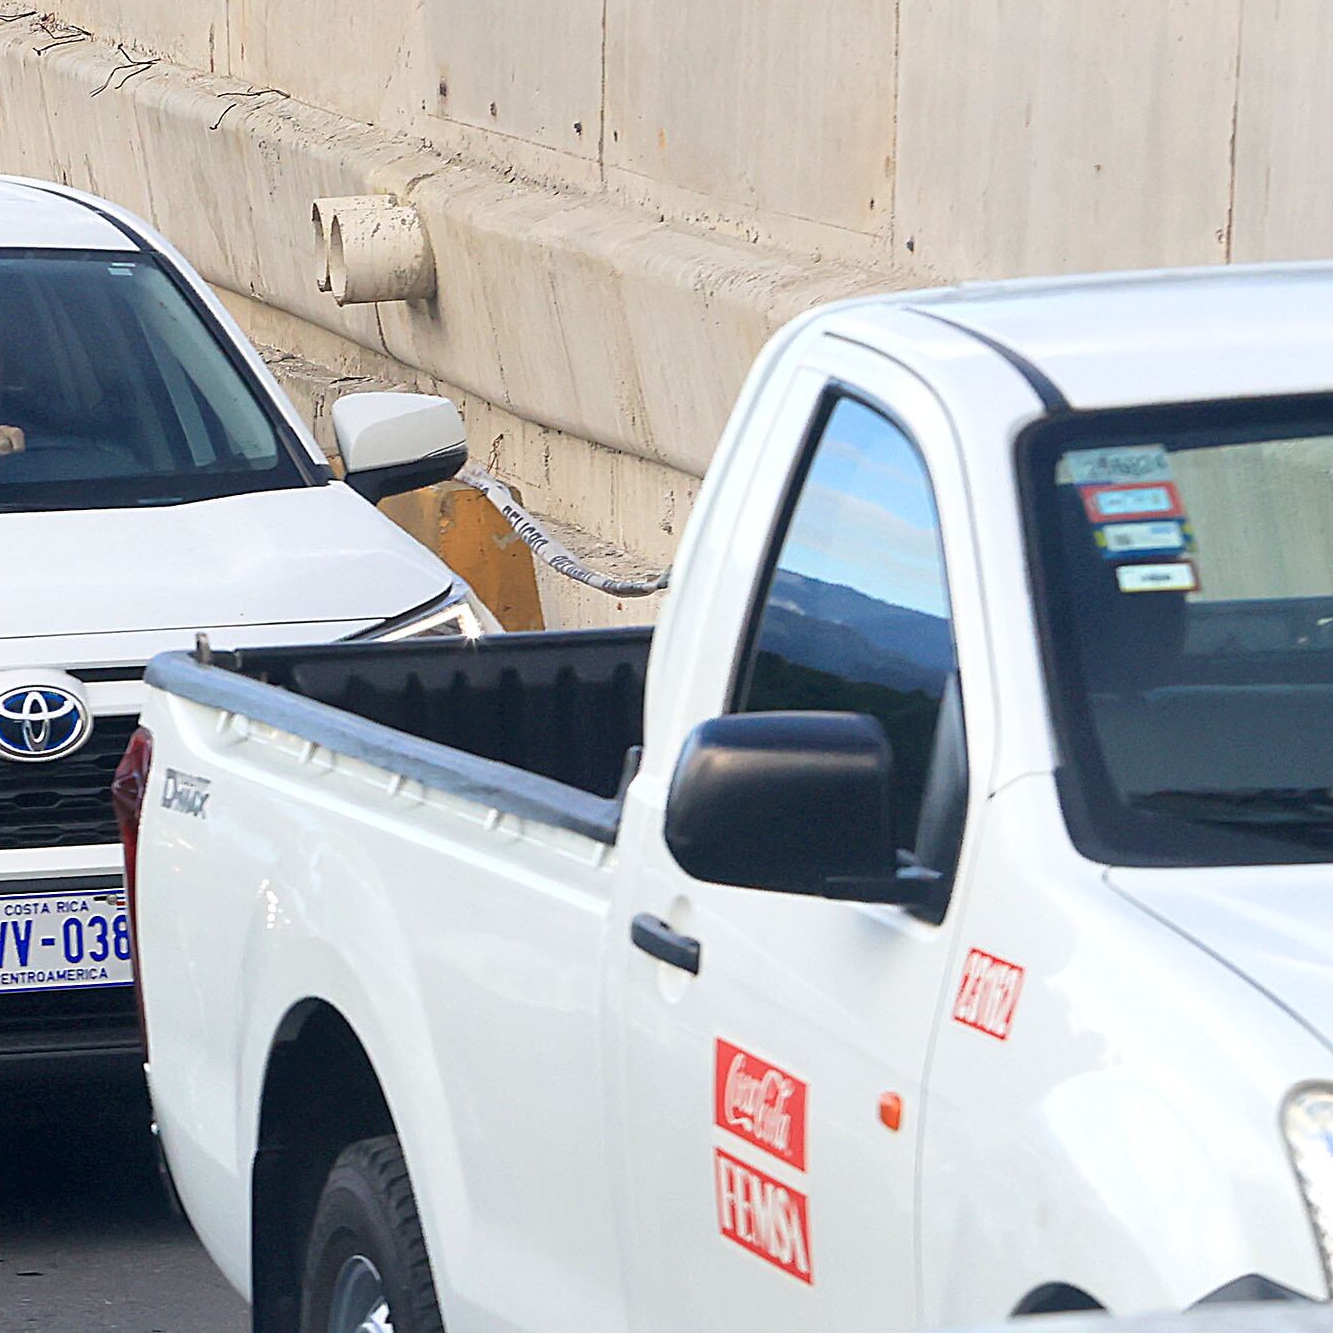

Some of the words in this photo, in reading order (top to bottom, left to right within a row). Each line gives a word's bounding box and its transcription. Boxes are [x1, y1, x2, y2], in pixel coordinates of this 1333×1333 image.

[4, 902, 52, 917] COSTA
[56, 900, 90, 914] RICA
[719, 1157, 810, 1275] FEMSA
